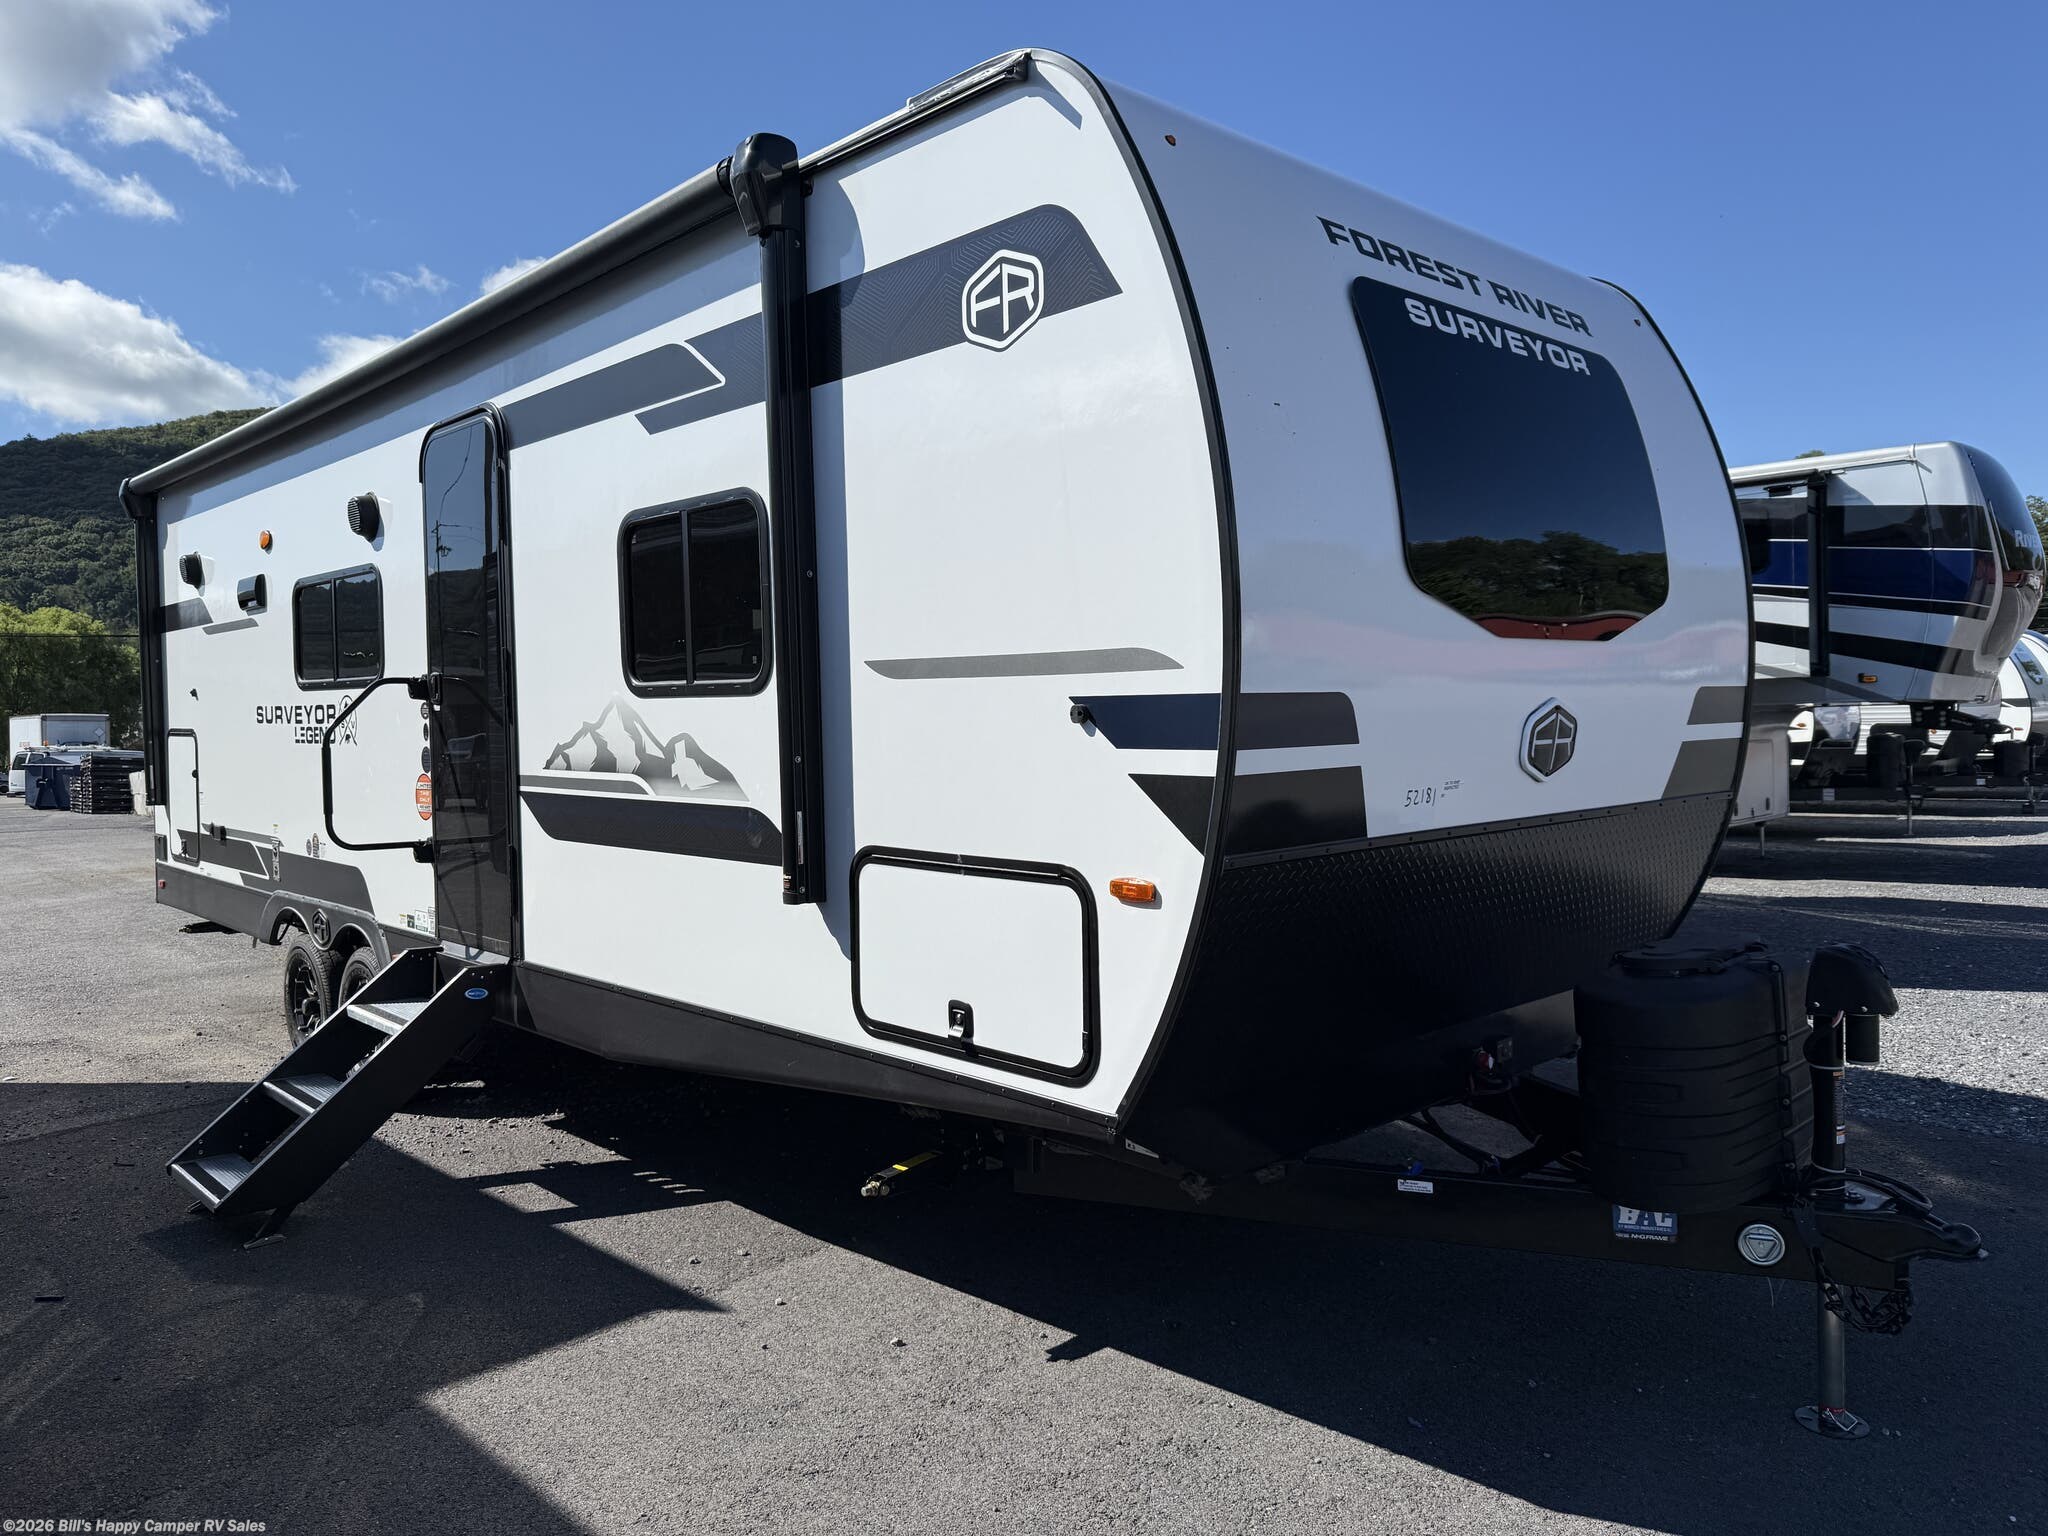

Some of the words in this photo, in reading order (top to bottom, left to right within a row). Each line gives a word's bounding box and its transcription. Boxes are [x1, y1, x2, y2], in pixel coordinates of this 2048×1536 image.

[1316, 215, 1481, 297] FOREST
[1487, 280, 1595, 338] RIVER
[1404, 297, 1592, 376] SURVEYOR
[256, 705, 336, 724] SURVEYOR
